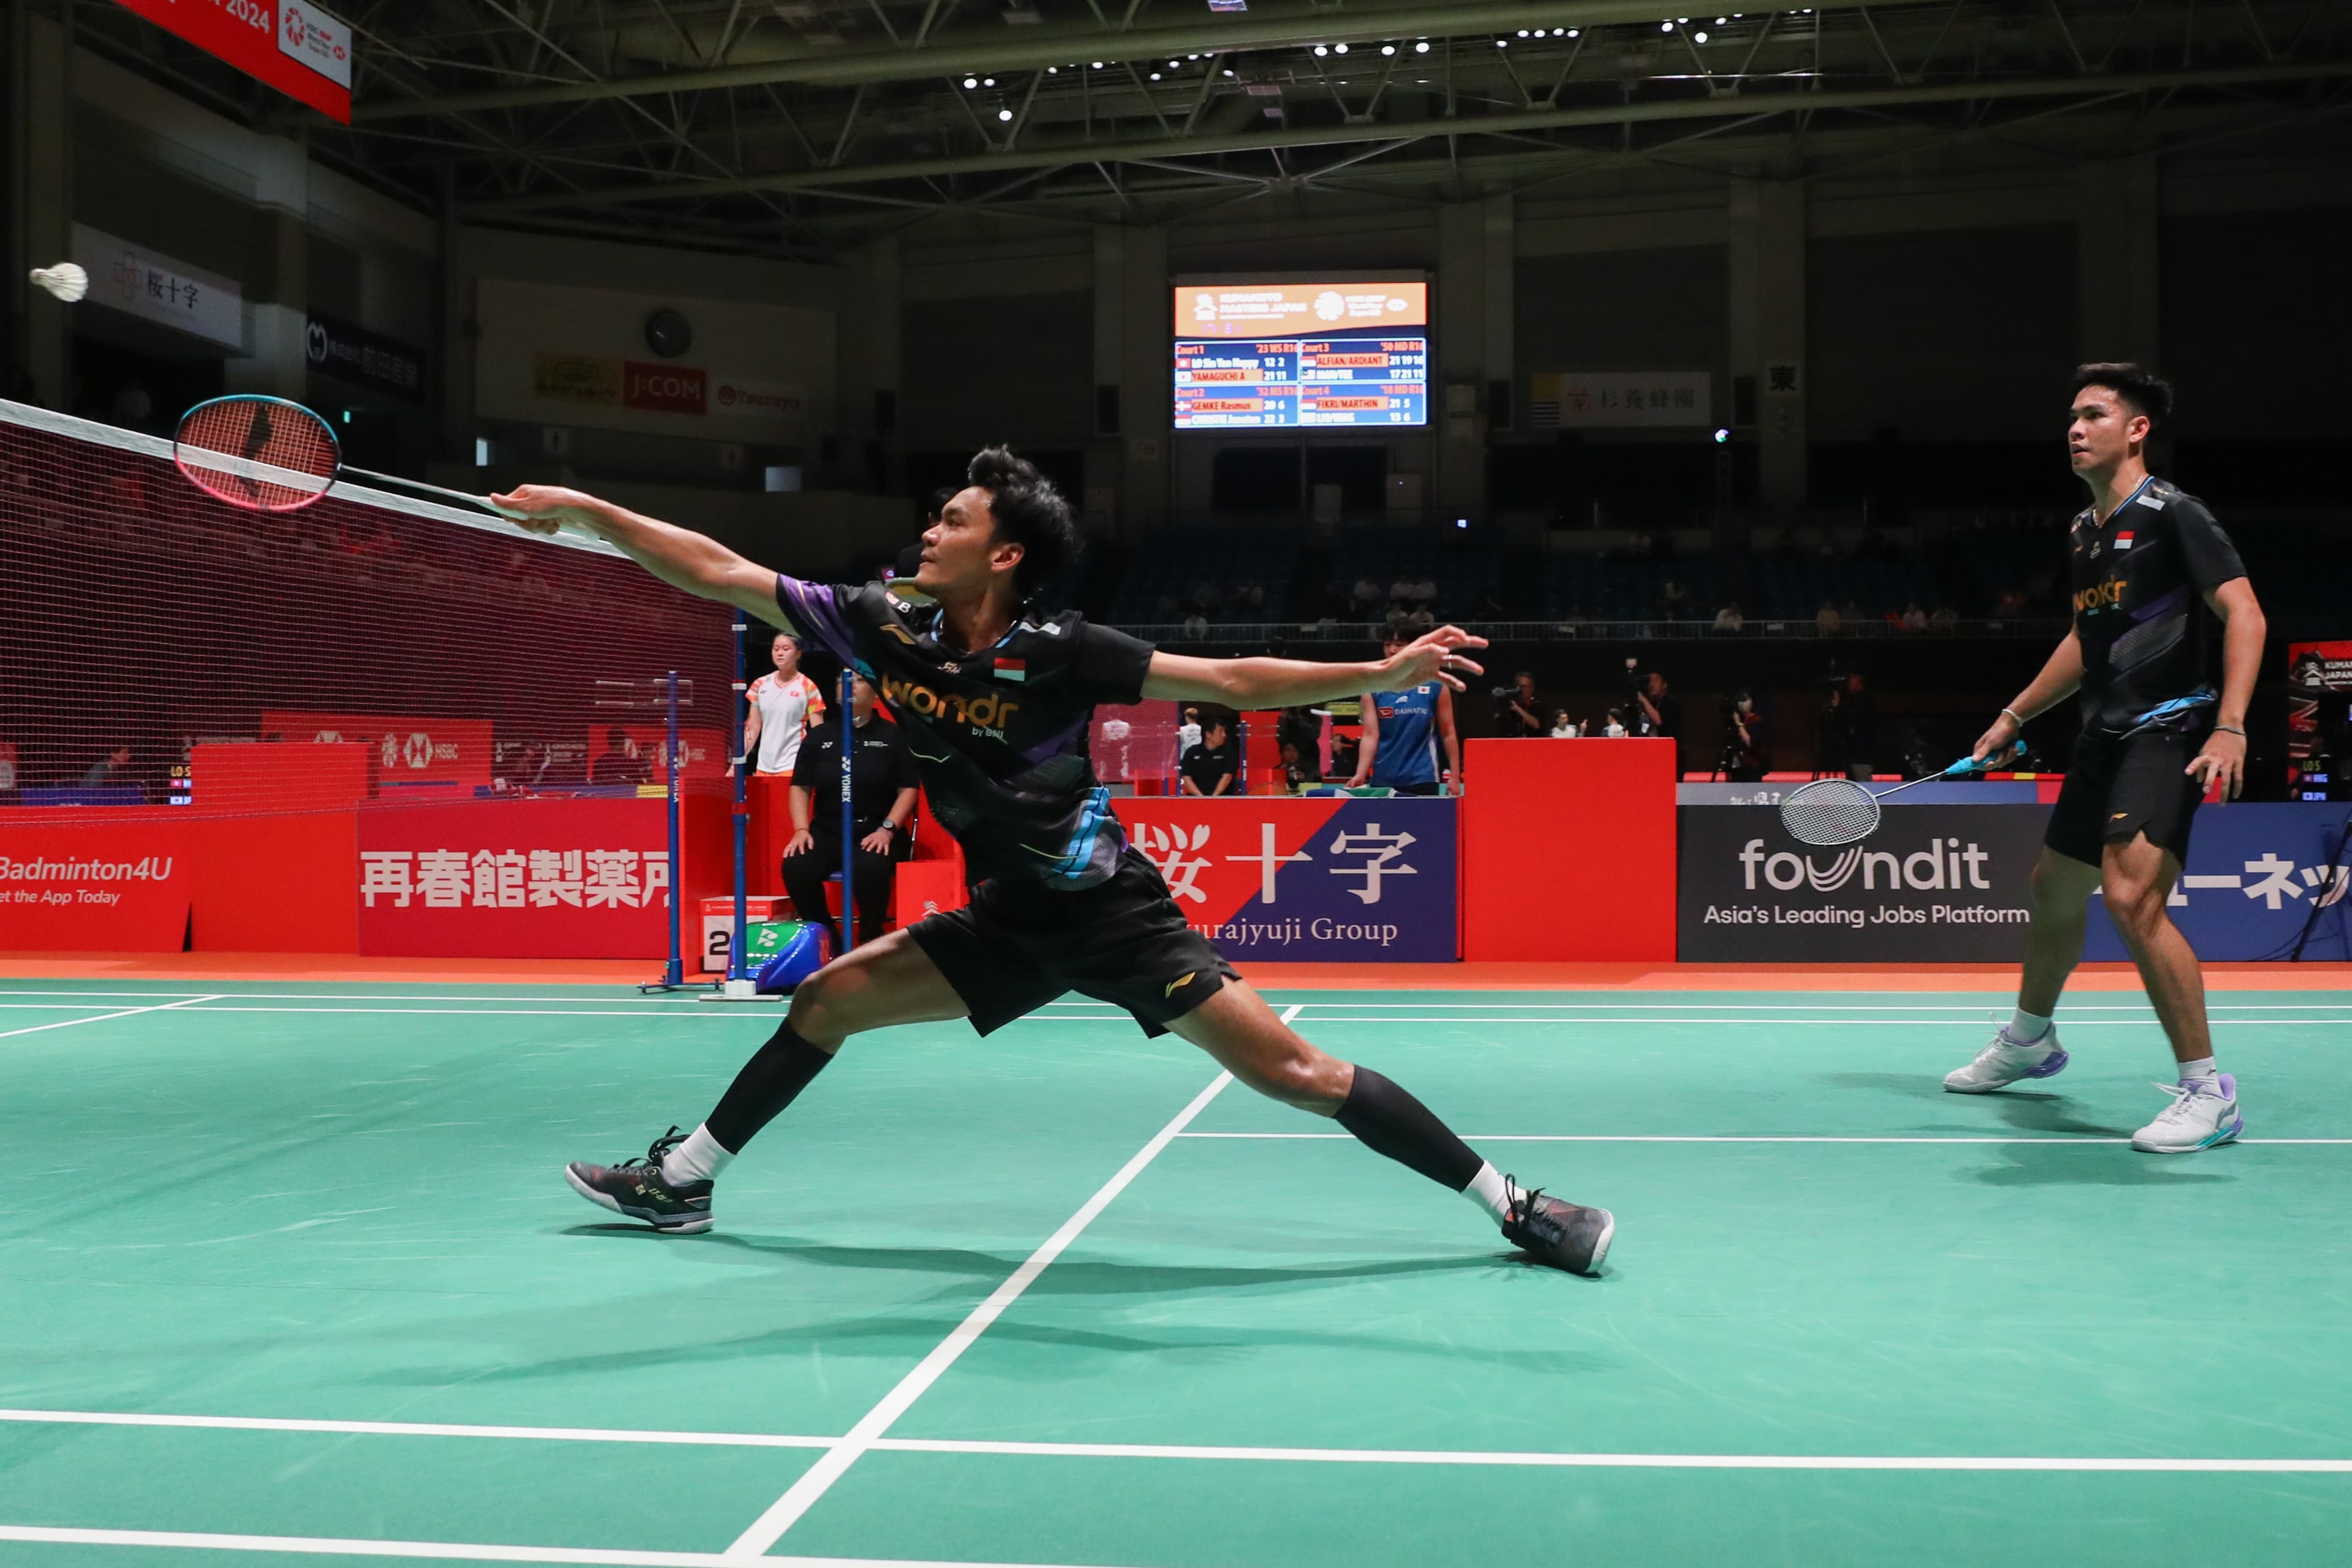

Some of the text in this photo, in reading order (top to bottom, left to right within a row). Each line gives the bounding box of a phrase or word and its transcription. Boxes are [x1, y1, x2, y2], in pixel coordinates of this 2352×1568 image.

[1278, 358, 1284, 367] 2
[1389, 356, 1400, 365] 21
[1193, 371, 1286, 380] YAMAGUCHI A 21 11
[1390, 369, 1400, 379] 17
[1401, 369, 1412, 379] 21
[1769, 366, 1796, 392] 東
[1193, 402, 1219, 410] GEMKE
[883, 675, 1019, 728] wondr
[972, 727, 1004, 739] by BNI
[435, 744, 458, 759] HSBC
[841, 774, 851, 803] YONEX
[1129, 823, 1418, 905] 桜十字
[1739, 838, 1990, 892] foundit
[14, 889, 37, 903] the
[40, 889, 72, 906] App
[76, 889, 121, 907] Today
[1703, 905, 2030, 928] Asia's Leading Jobs Platform
[1186, 918, 1398, 946] urajyuji Group
[709, 930, 731, 956] 2
